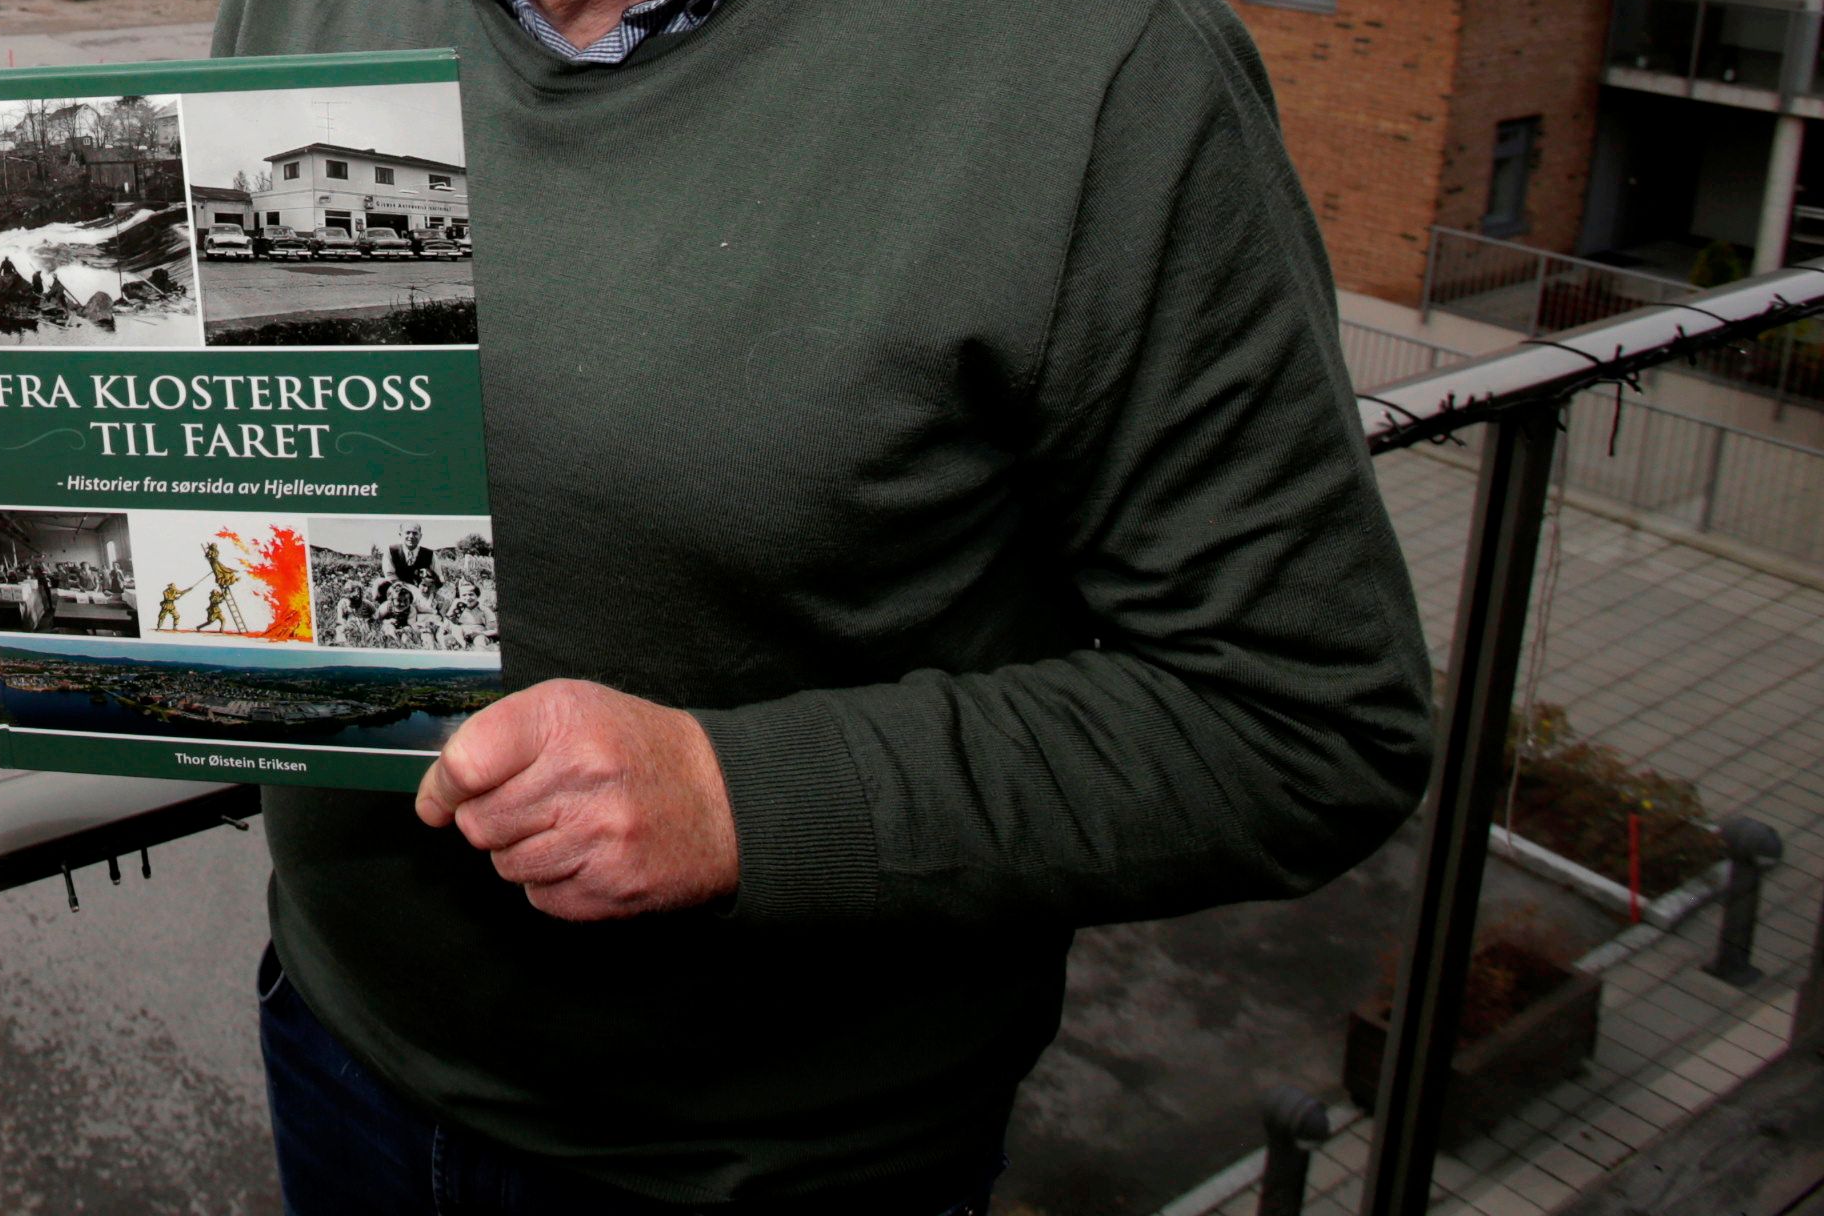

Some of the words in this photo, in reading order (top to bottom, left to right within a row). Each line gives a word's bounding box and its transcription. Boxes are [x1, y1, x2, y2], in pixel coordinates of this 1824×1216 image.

[90, 374, 432, 412] KLOSTERFOSS
[89, 421, 168, 457] TIL
[180, 422, 330, 459] FARET
[67, 474, 141, 493] Historier
[142, 475, 168, 493] fra
[171, 477, 235, 495] sørsida
[237, 482, 259, 495] av
[264, 479, 378, 498] Hjellevannet
[174, 752, 206, 766] Thor
[208, 754, 256, 769] Øistein
[258, 757, 307, 772] Eriksen
